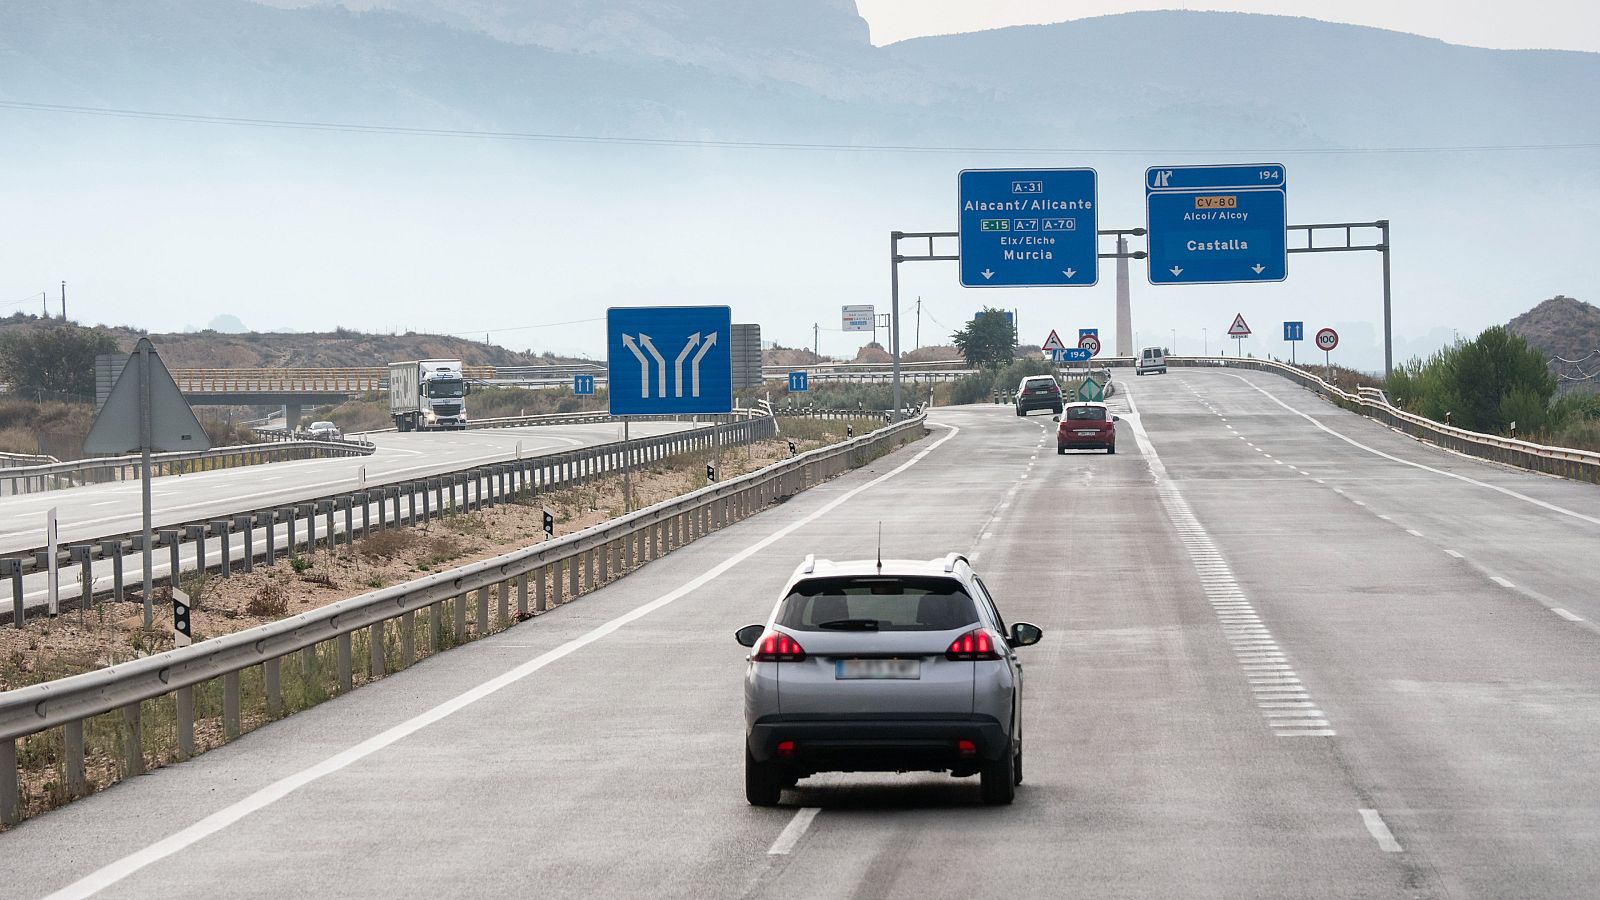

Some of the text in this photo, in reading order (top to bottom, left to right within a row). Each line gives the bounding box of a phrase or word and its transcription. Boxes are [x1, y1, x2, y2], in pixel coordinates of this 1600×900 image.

[1259, 171, 1279, 180] 194
[1014, 183, 1041, 192] A-31
[964, 199, 1092, 211] Alacant/Alicante
[1197, 198, 1235, 207] CV-80
[1183, 211, 1248, 221] Alcoi/Alcoy
[982, 220, 1074, 230] E-15 A-7 A-70
[1000, 236, 1055, 245] Elx/Elche
[1187, 239, 1248, 251] Castalla
[1004, 249, 1053, 260] Murcia
[1320, 335, 1335, 344] 100
[1082, 342, 1097, 350] 100
